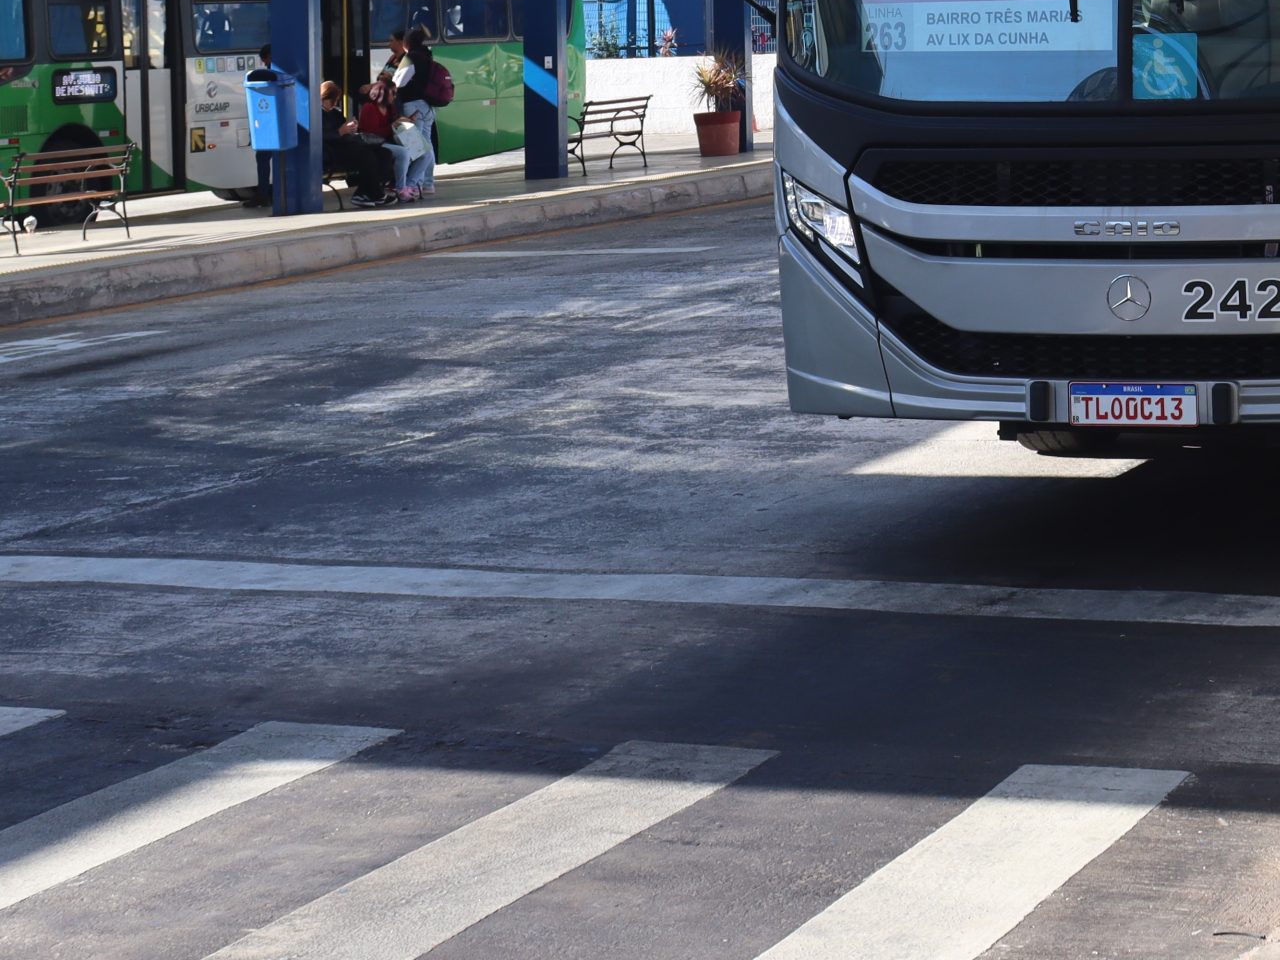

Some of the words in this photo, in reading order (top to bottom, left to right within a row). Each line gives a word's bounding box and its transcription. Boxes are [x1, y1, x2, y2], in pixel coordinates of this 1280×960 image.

[868, 7, 903, 19] LINHA
[926, 11, 981, 25] BAIRRO
[985, 8, 1022, 23] TRÊS
[866, 21, 907, 52] 263
[926, 35, 944, 46] AV
[949, 34, 970, 46] LIX
[975, 33, 993, 45] DA
[998, 32, 1049, 45] CUNHA
[1073, 220, 1181, 236] CAIO
